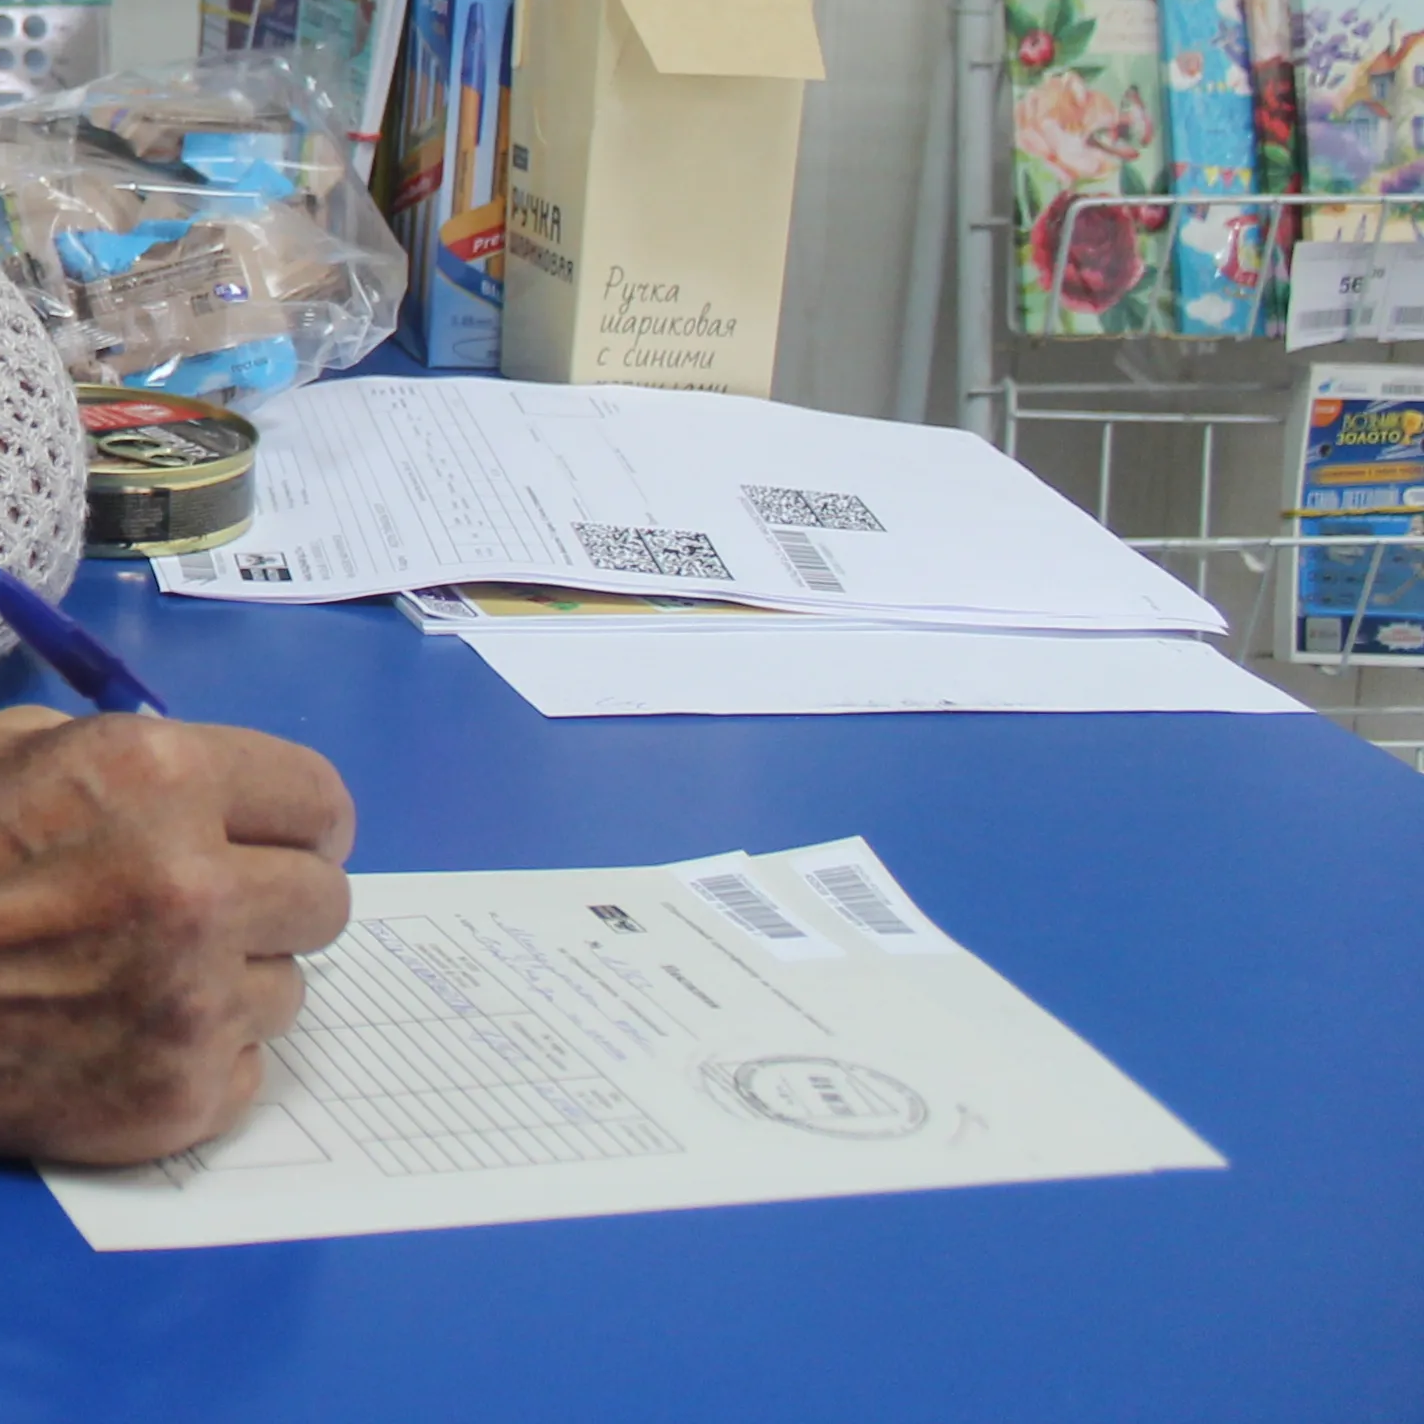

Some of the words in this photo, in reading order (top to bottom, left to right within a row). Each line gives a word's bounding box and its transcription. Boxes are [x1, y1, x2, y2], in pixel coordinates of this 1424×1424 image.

[511, 186, 562, 245] РУЧКА
[472, 233, 505, 254] Pre
[603, 264, 681, 315] Ручка
[599, 301, 738, 348] шариковая
[596, 346, 611, 367] с
[623, 347, 716, 370] синими
